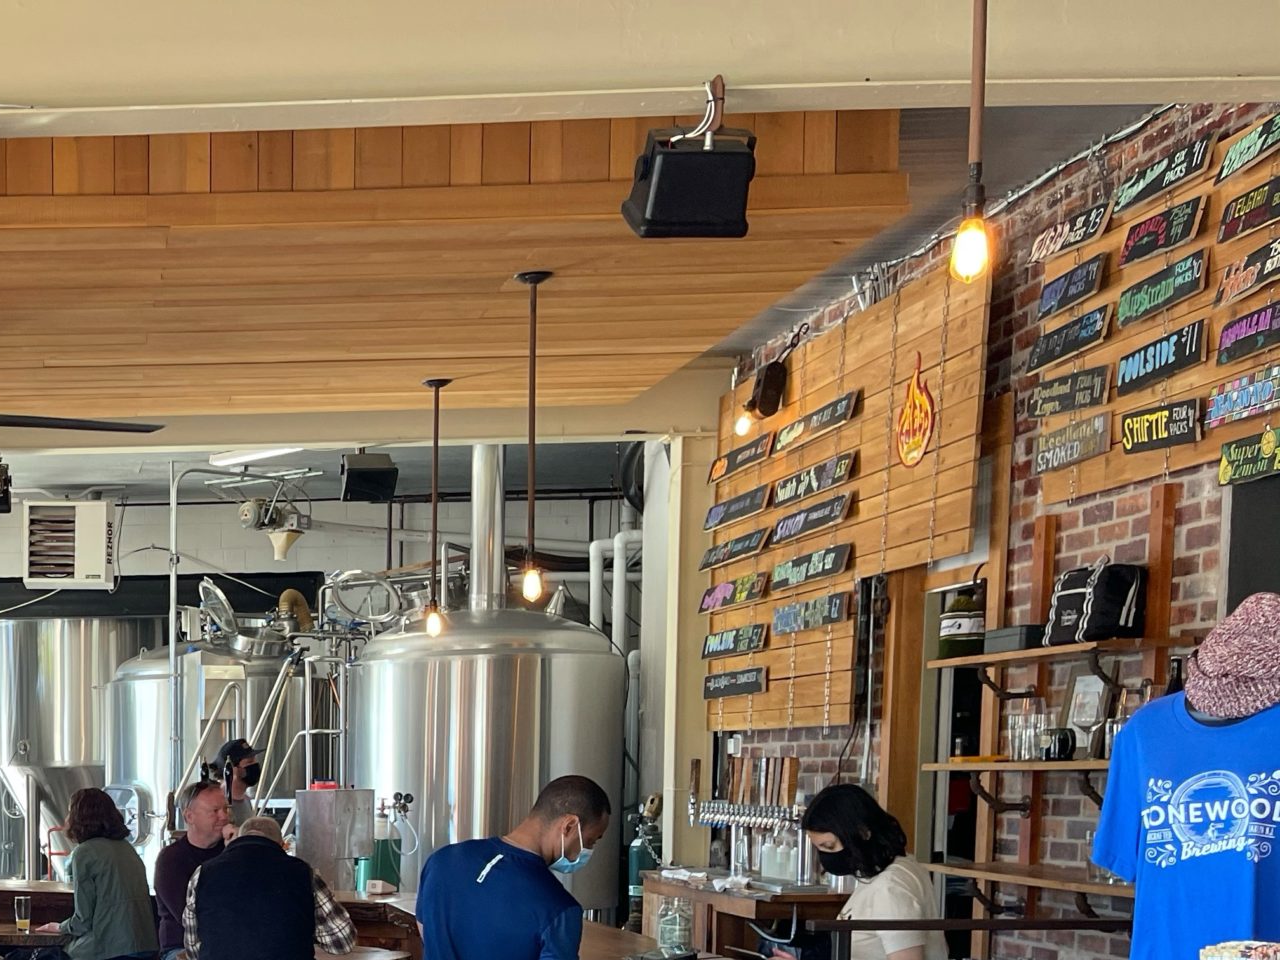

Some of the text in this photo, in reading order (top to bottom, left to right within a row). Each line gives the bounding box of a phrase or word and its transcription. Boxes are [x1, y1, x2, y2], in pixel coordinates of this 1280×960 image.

[1175, 257, 1193, 276] FOUR
[1117, 334, 1178, 387] POOLSIDE
[1181, 322, 1199, 356] $11
[1123, 410, 1169, 450] SHIFTIE
[1172, 405, 1188, 420] FOUR
[1169, 420, 1188, 436] PACKS
[1036, 441, 1081, 472] SMOKED
[1230, 443, 1261, 464] Super
[1231, 458, 1269, 479] Lemon
[1181, 836, 1253, 861] Brewing
